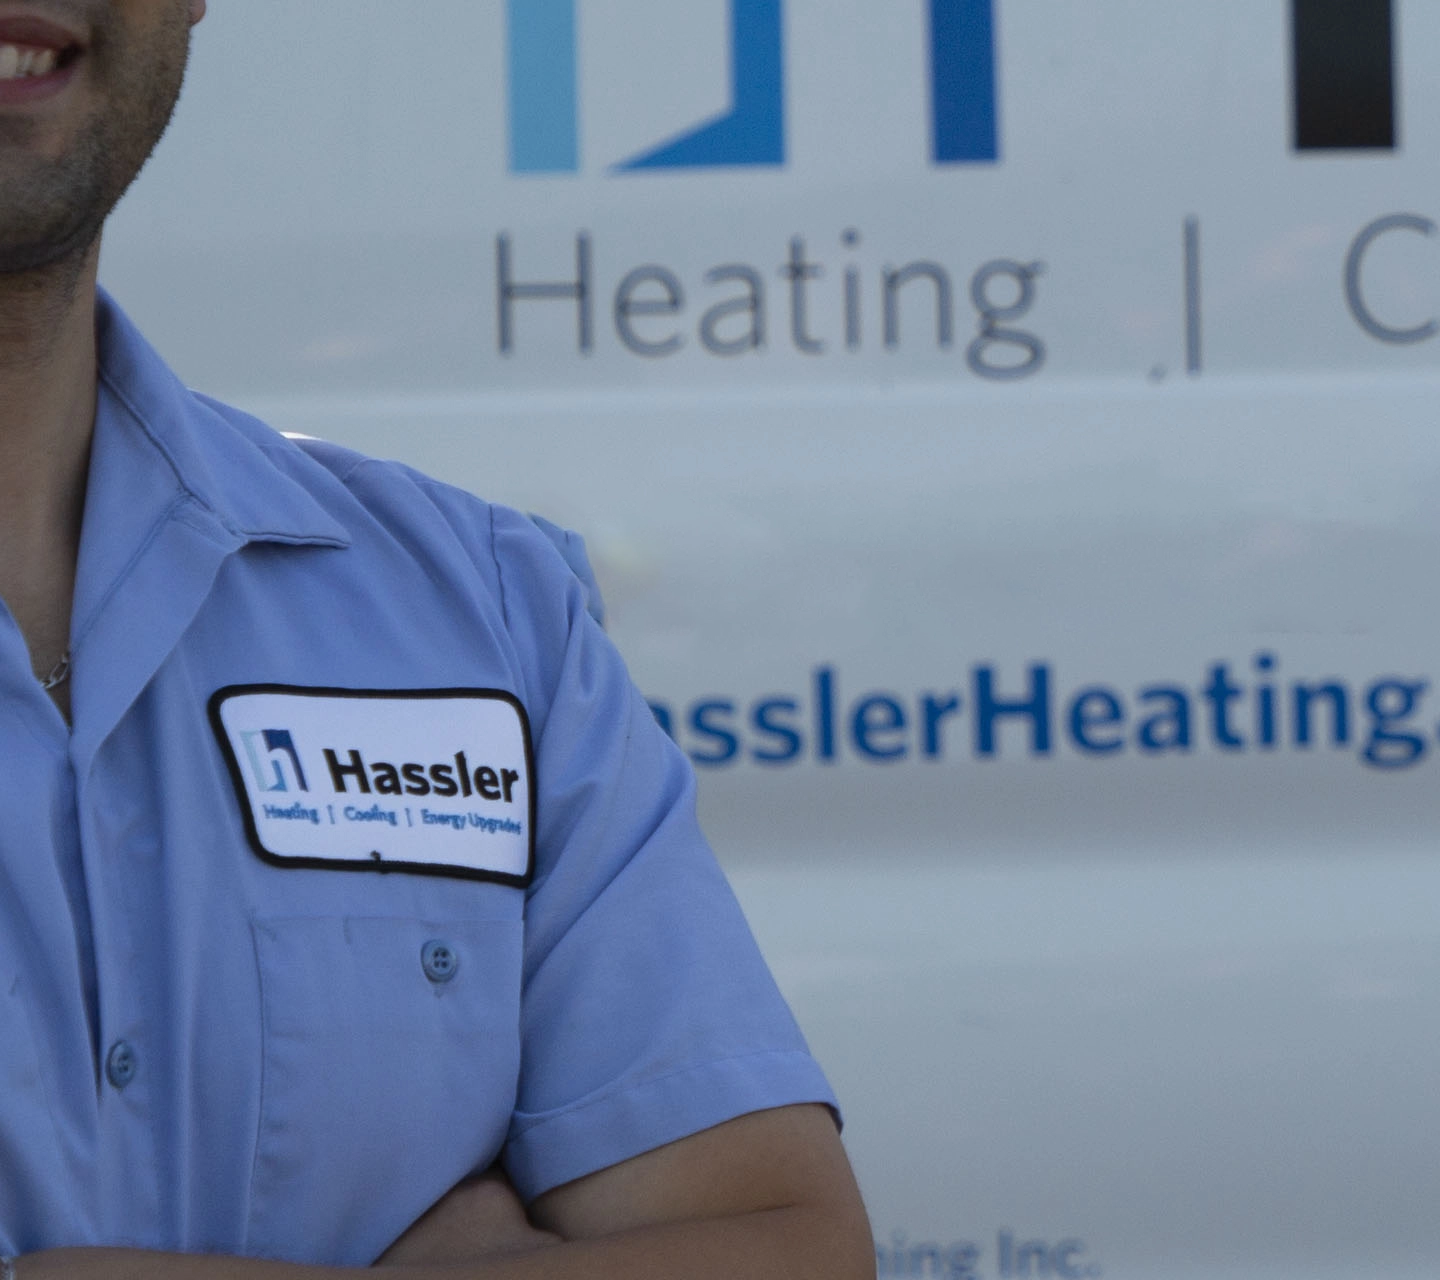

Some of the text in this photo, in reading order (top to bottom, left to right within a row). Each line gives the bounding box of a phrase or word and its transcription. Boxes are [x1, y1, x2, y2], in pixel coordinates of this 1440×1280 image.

[492, 225, 1048, 383] Heating
[322, 748, 519, 803] Hassler
[344, 803, 397, 827] Cooling
[421, 808, 466, 831] Energy
